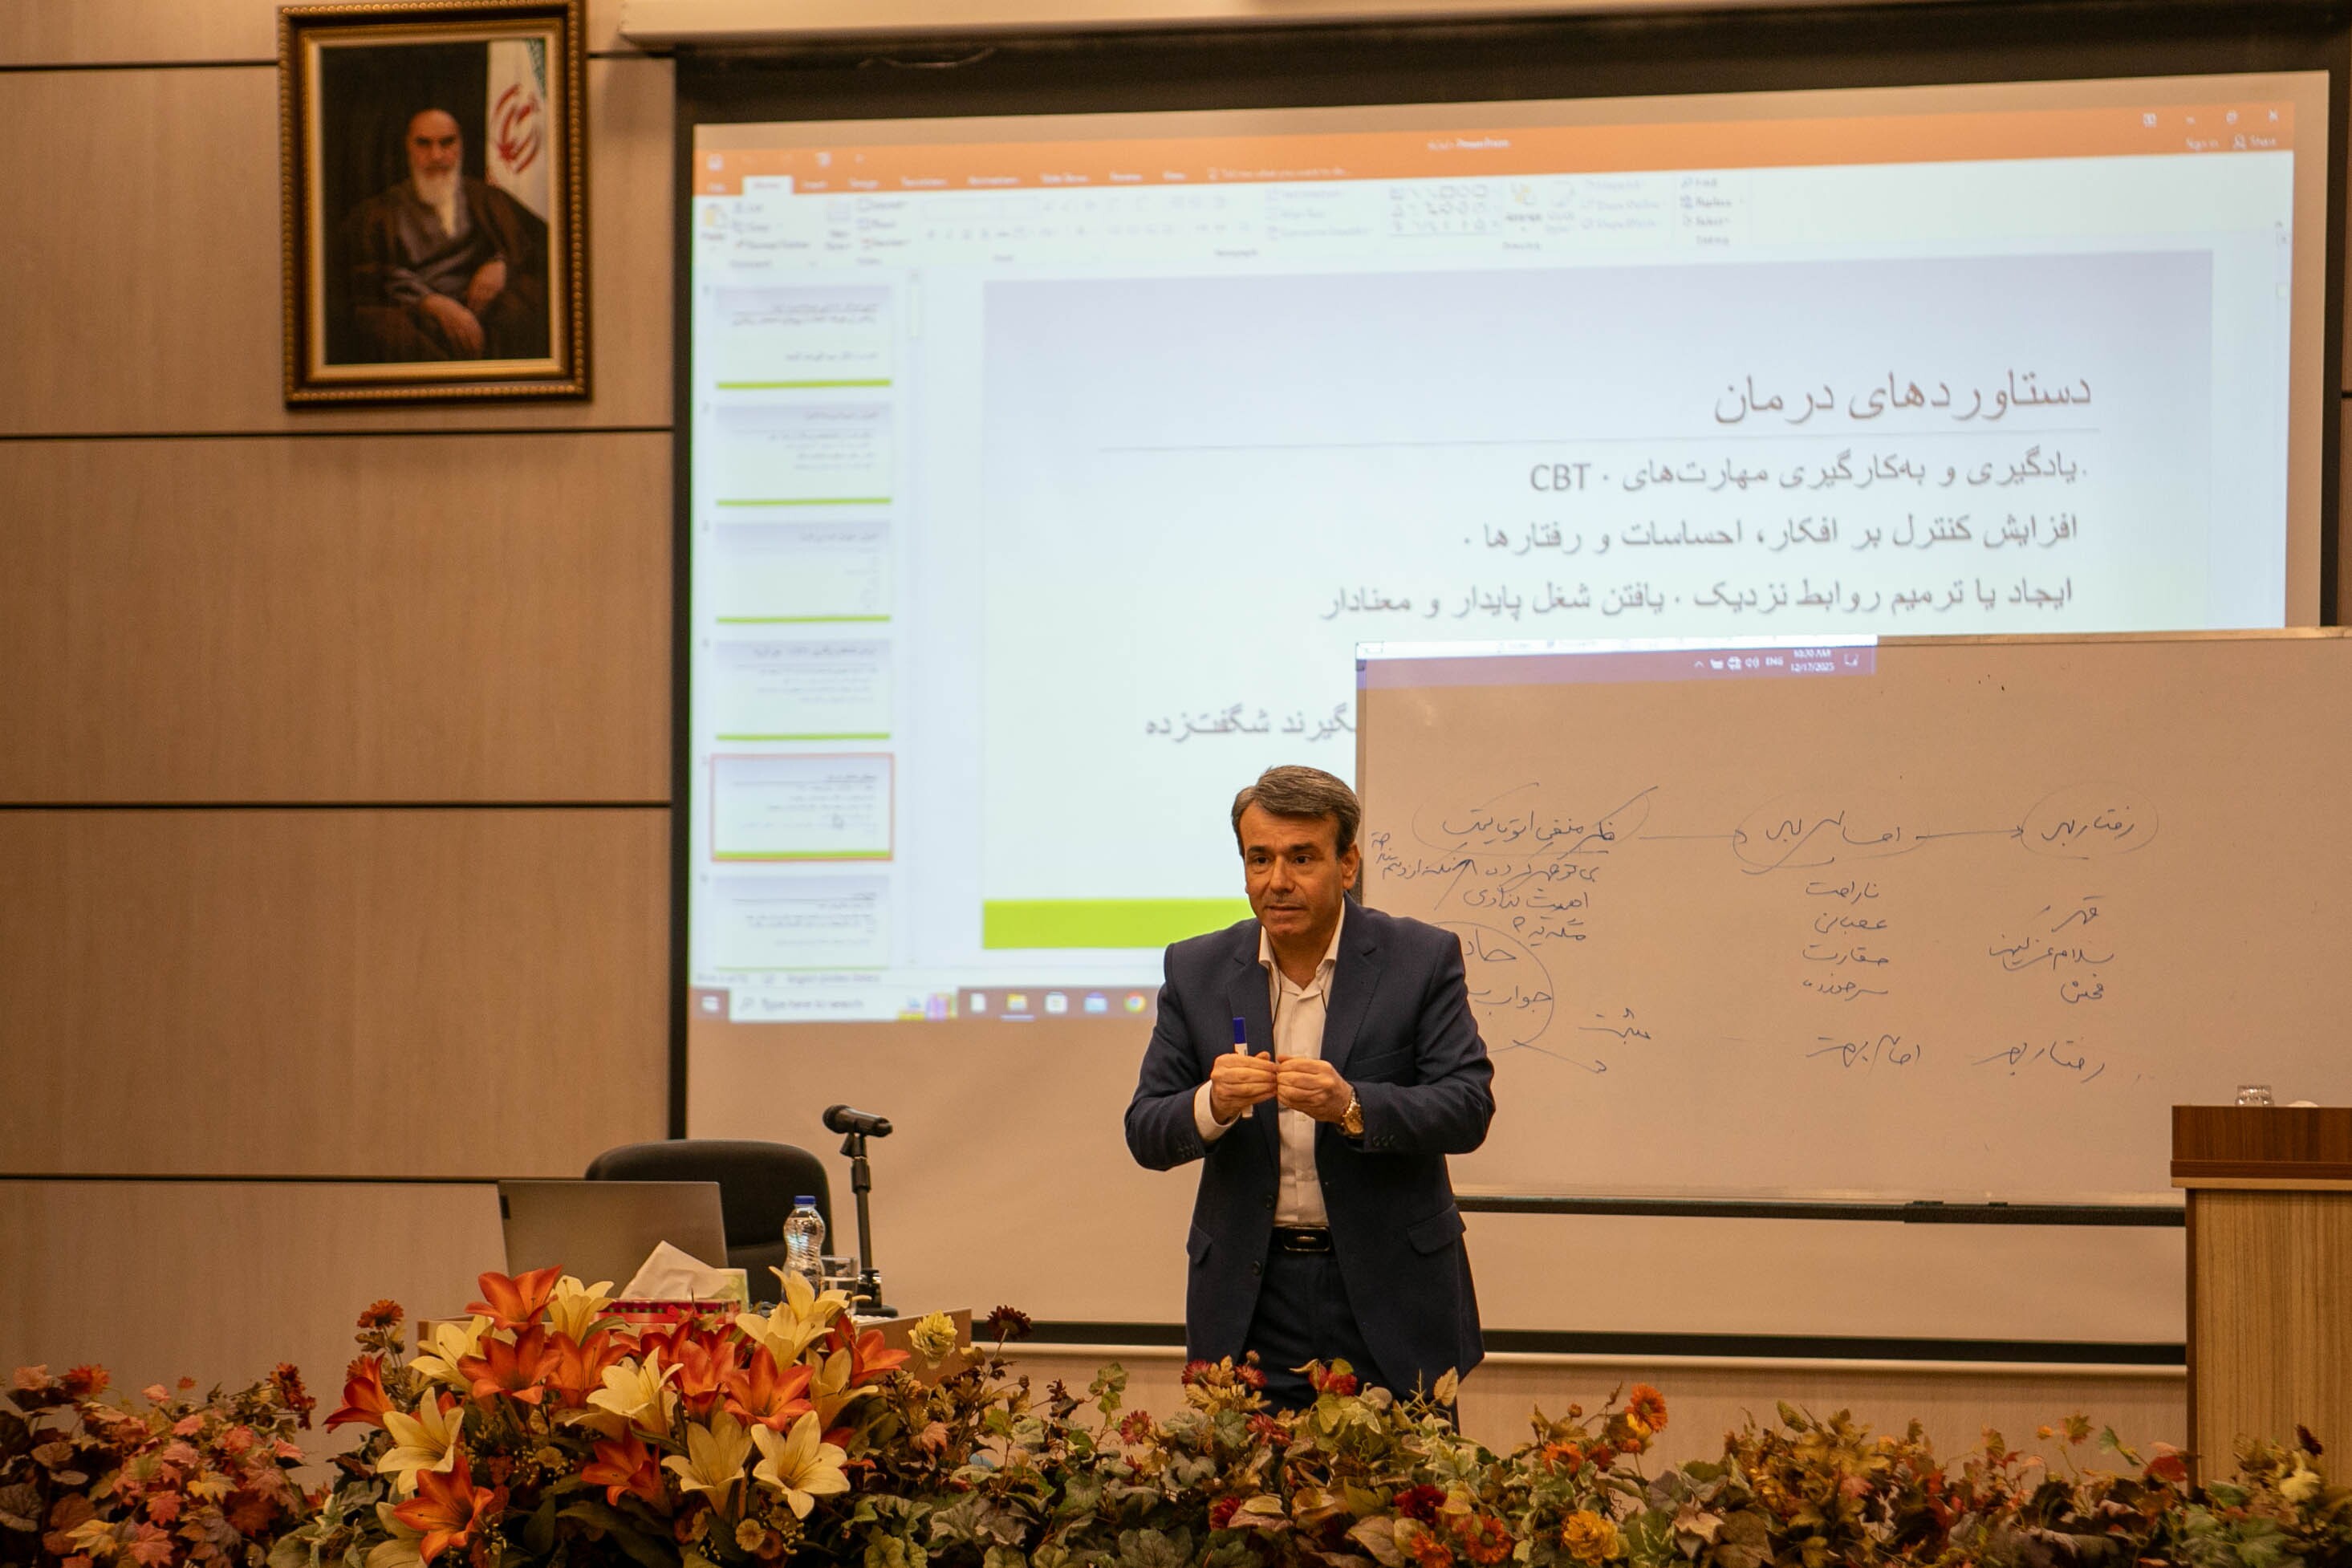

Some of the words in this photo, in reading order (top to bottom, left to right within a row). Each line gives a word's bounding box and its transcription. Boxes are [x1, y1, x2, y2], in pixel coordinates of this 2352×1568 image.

[1715, 374, 1834, 425] درمان
[1849, 368, 2091, 421] دستاوردهای
[1530, 462, 1592, 492] CBT
[1939, 466, 1956, 488] و
[1594, 534, 1611, 555] و
[1621, 518, 1743, 546] احساسات
[1851, 526, 1882, 552] بر
[1892, 513, 1972, 550] کنترل
[1983, 513, 2077, 550] افزایش
[1319, 587, 1412, 621] معنادار
[1424, 598, 1440, 619] و
[1451, 584, 1522, 622] پایدار
[1533, 581, 1591, 615] شغل
[1601, 582, 1665, 616] یافتن
[1693, 581, 1788, 615] نزدیک
[1795, 578, 1880, 613] روابط
[1891, 579, 1964, 615] ترمیم
[1975, 578, 1997, 610] یا
[2008, 576, 2072, 610] ایجاد
[1282, 702, 1356, 741] گیرند
[1536, 817, 1584, 842] منفی
